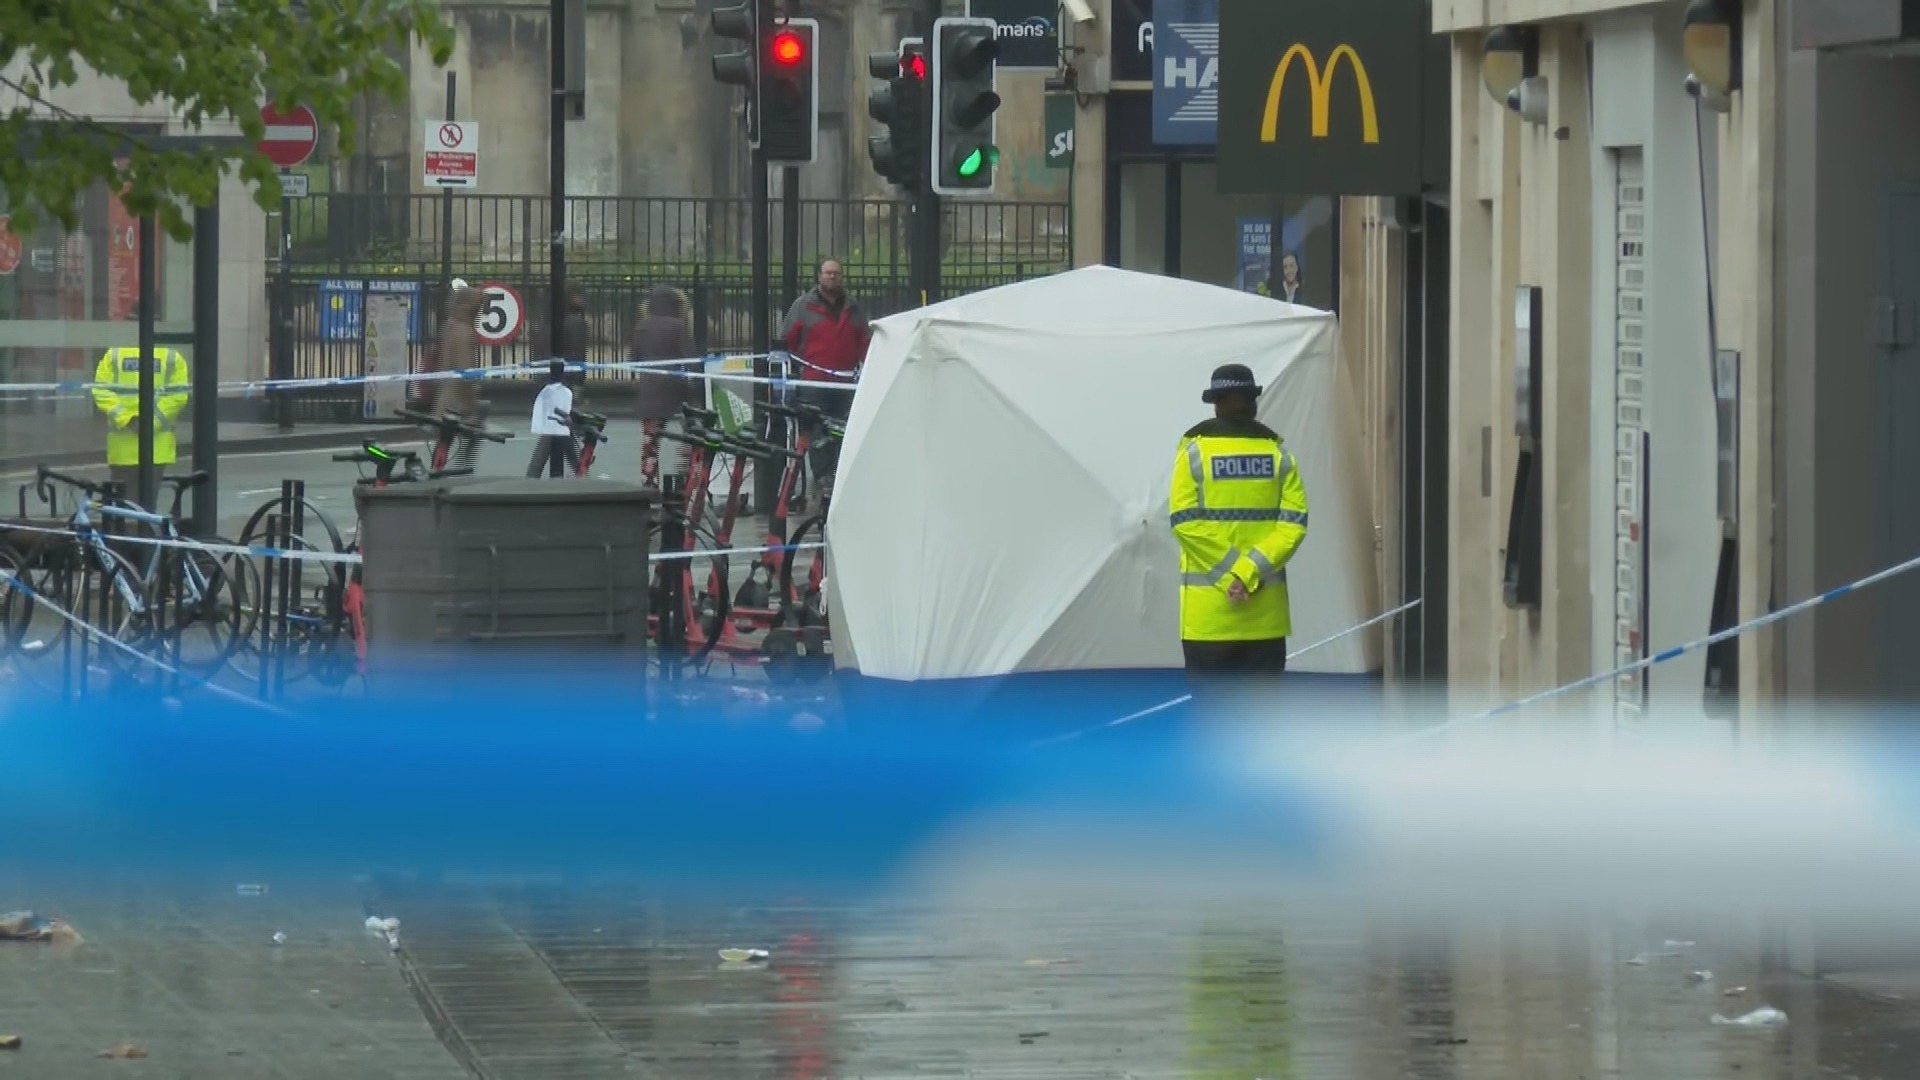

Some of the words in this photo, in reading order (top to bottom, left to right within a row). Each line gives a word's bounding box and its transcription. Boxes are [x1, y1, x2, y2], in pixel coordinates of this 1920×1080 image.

[326, 280, 343, 289] ALL
[344, 280, 389, 290] VEHCLES
[390, 281, 417, 290] MUST
[482, 293, 507, 333] 5
[1214, 457, 1272, 476] POLICE
